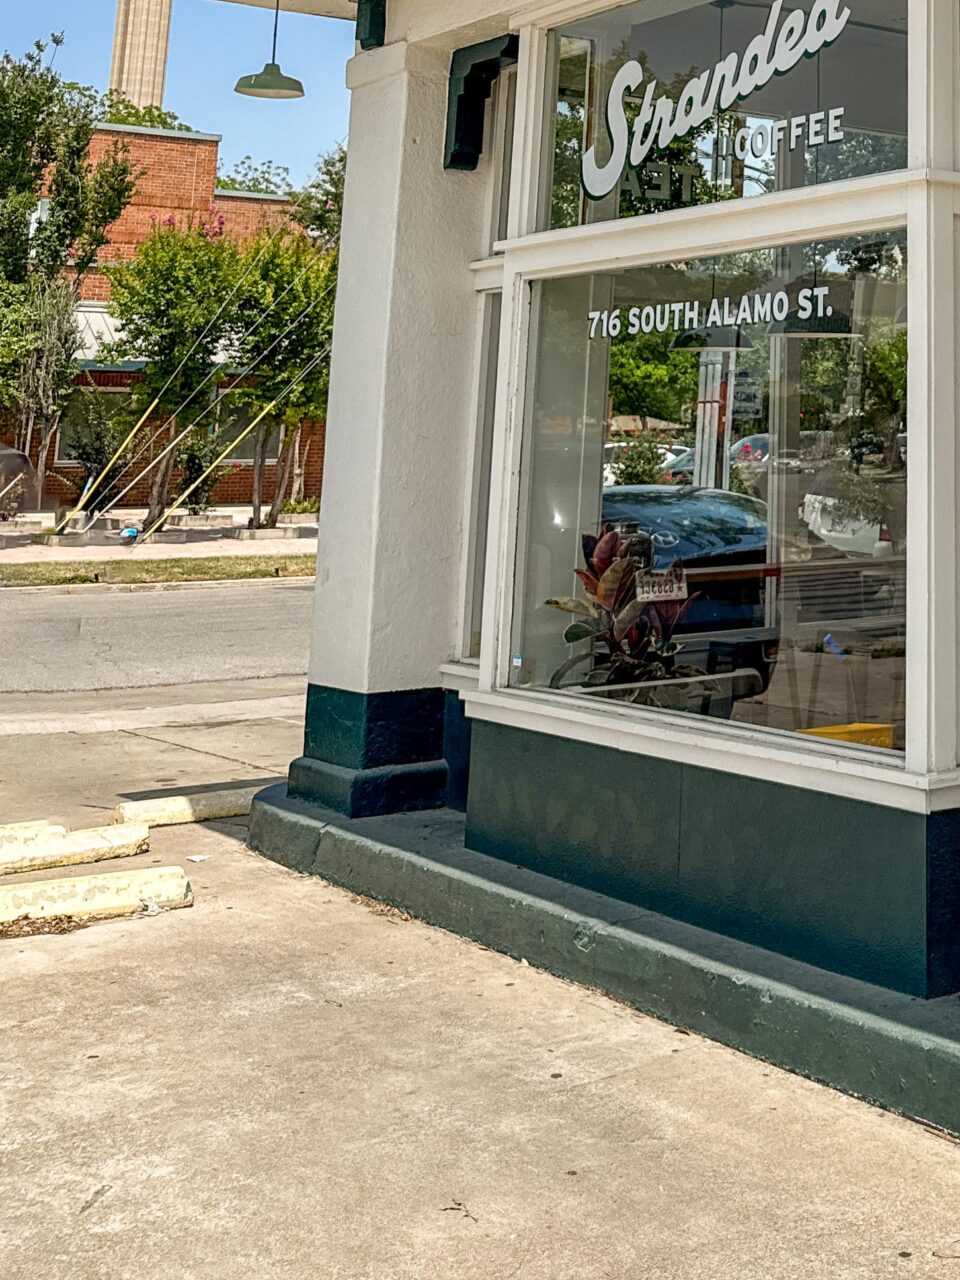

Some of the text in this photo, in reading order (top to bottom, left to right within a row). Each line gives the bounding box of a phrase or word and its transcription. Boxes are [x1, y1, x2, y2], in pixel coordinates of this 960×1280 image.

[734, 107, 845, 161] COFFEE
[588, 286, 833, 338] 716 SOUTH ALAMO ST.
